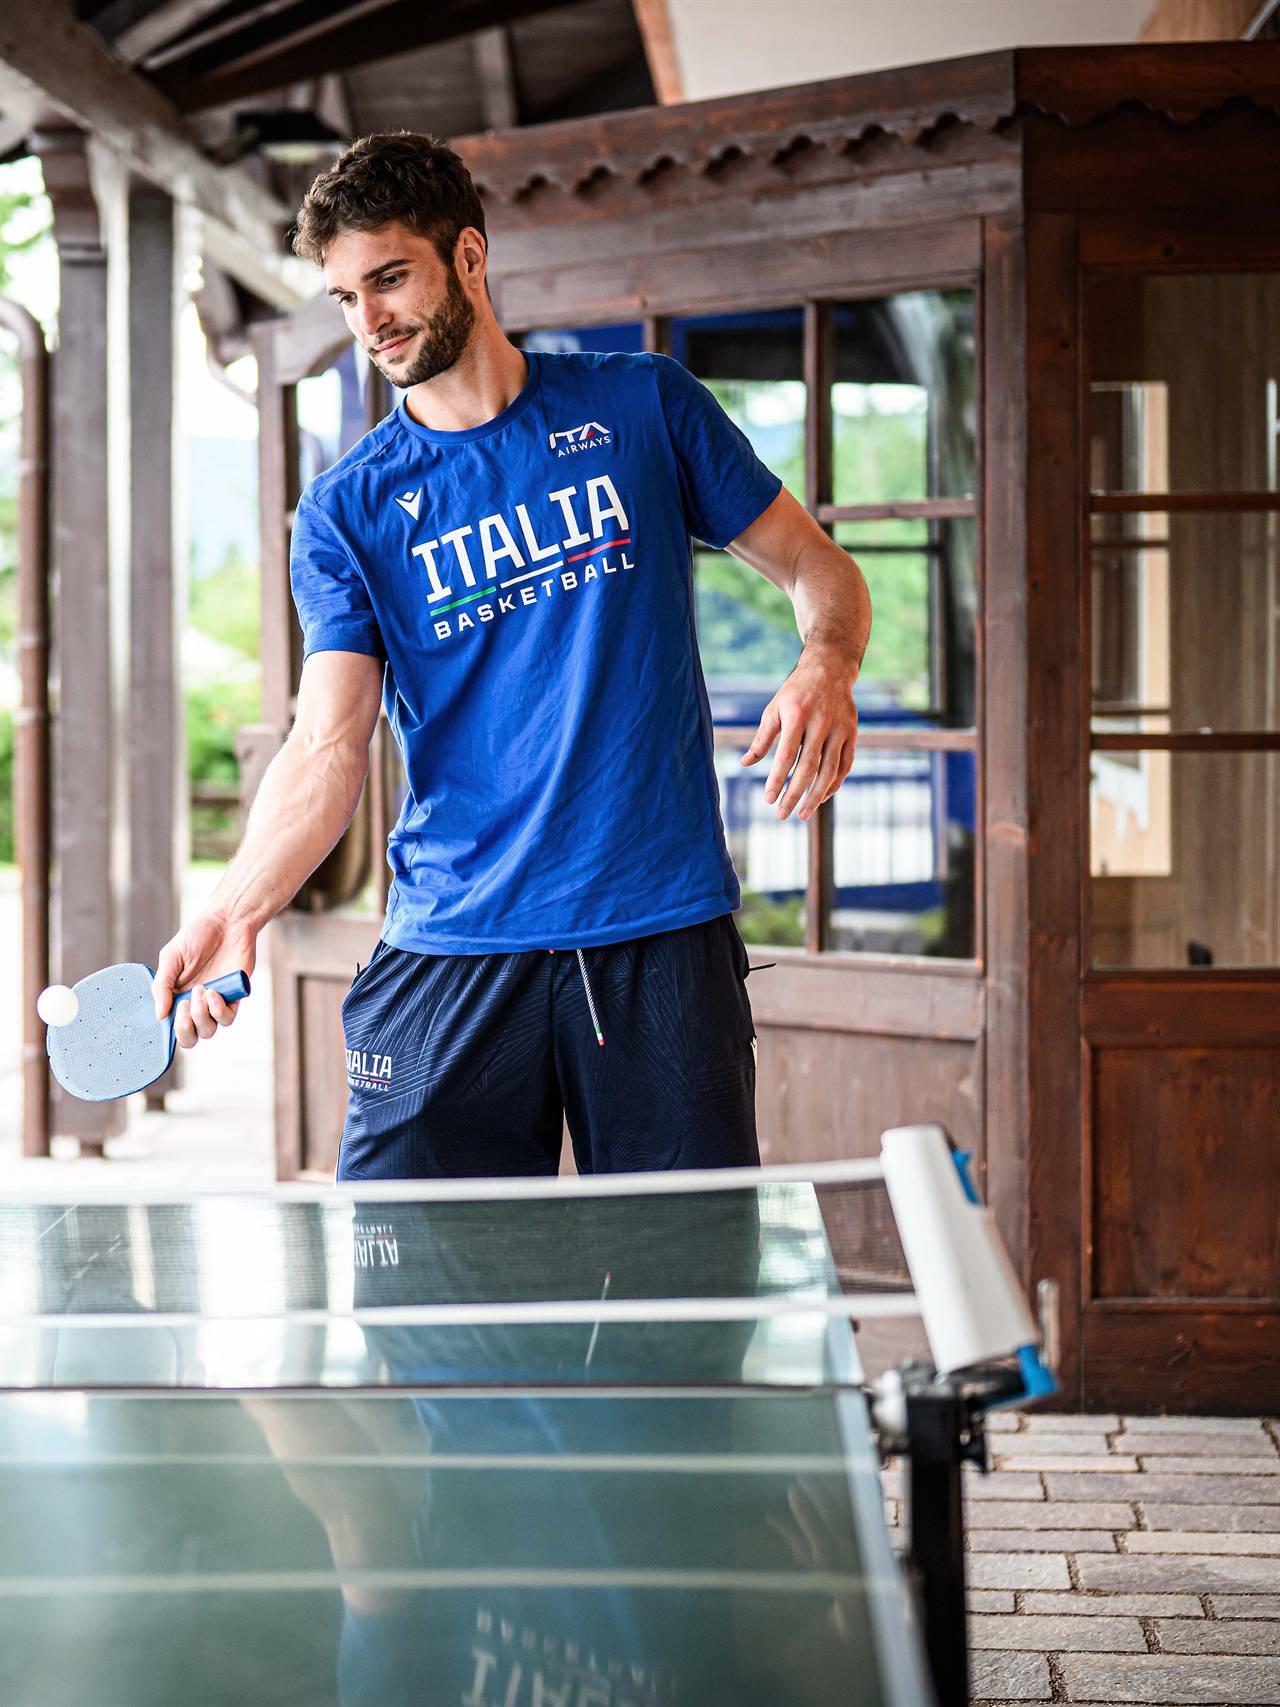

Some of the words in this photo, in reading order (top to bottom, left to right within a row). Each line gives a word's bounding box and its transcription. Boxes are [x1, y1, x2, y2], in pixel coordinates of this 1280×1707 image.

[549, 421, 611, 449] ITA
[557, 435, 611, 458] AIRWAYS
[411, 474, 629, 604] ITALIA
[433, 553, 635, 641] BASKETBALL
